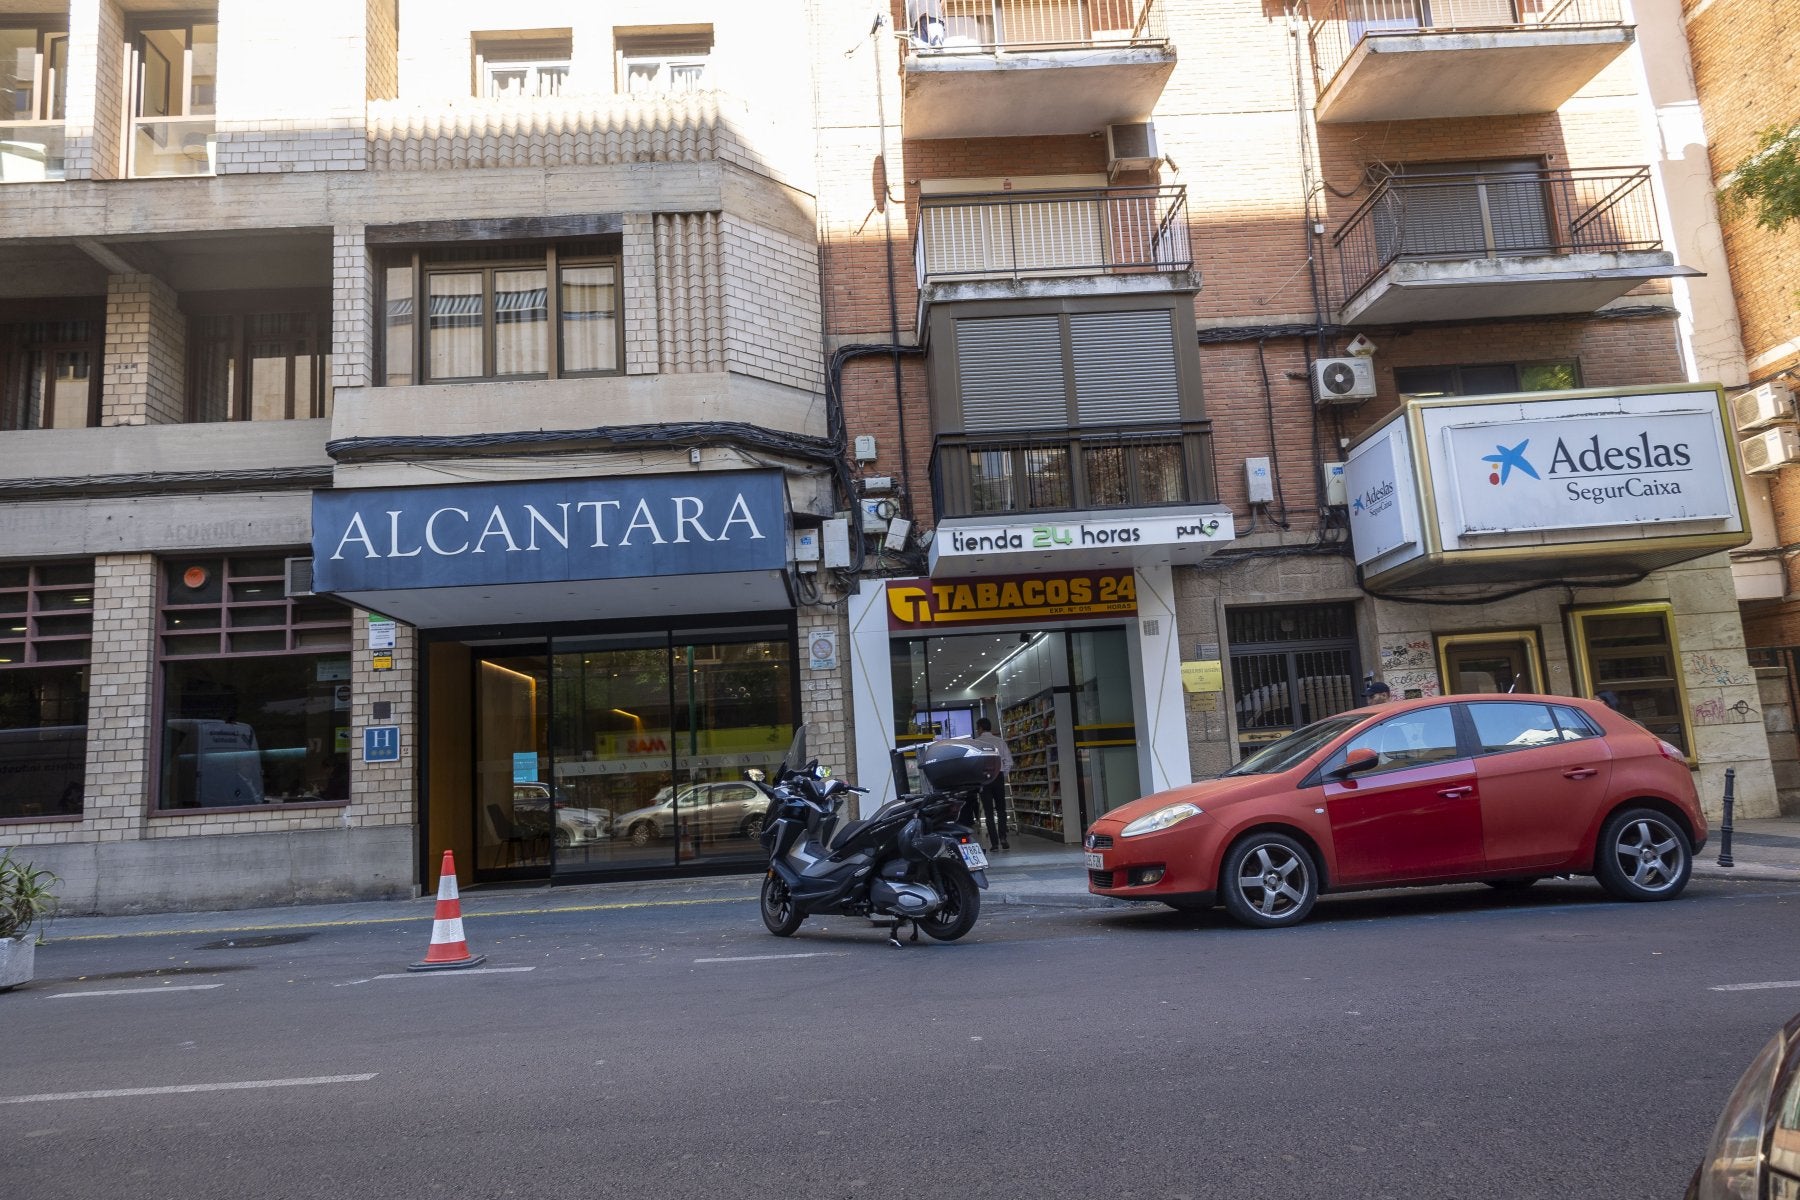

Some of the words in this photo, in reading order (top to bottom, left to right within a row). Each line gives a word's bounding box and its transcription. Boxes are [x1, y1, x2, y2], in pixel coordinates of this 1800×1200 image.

[1548, 431, 1691, 474] Adeslas
[1365, 481, 1393, 508] Adeslas
[1566, 478, 1682, 504] SegurCaixa
[330, 493, 765, 560] ALCANTARA
[952, 529, 1023, 551] tienda
[1032, 526, 1073, 548] 24
[1081, 524, 1140, 545] horas
[932, 577, 1092, 610] TABACOS
[1099, 575, 1136, 600] 24
[371, 730, 392, 748] H
